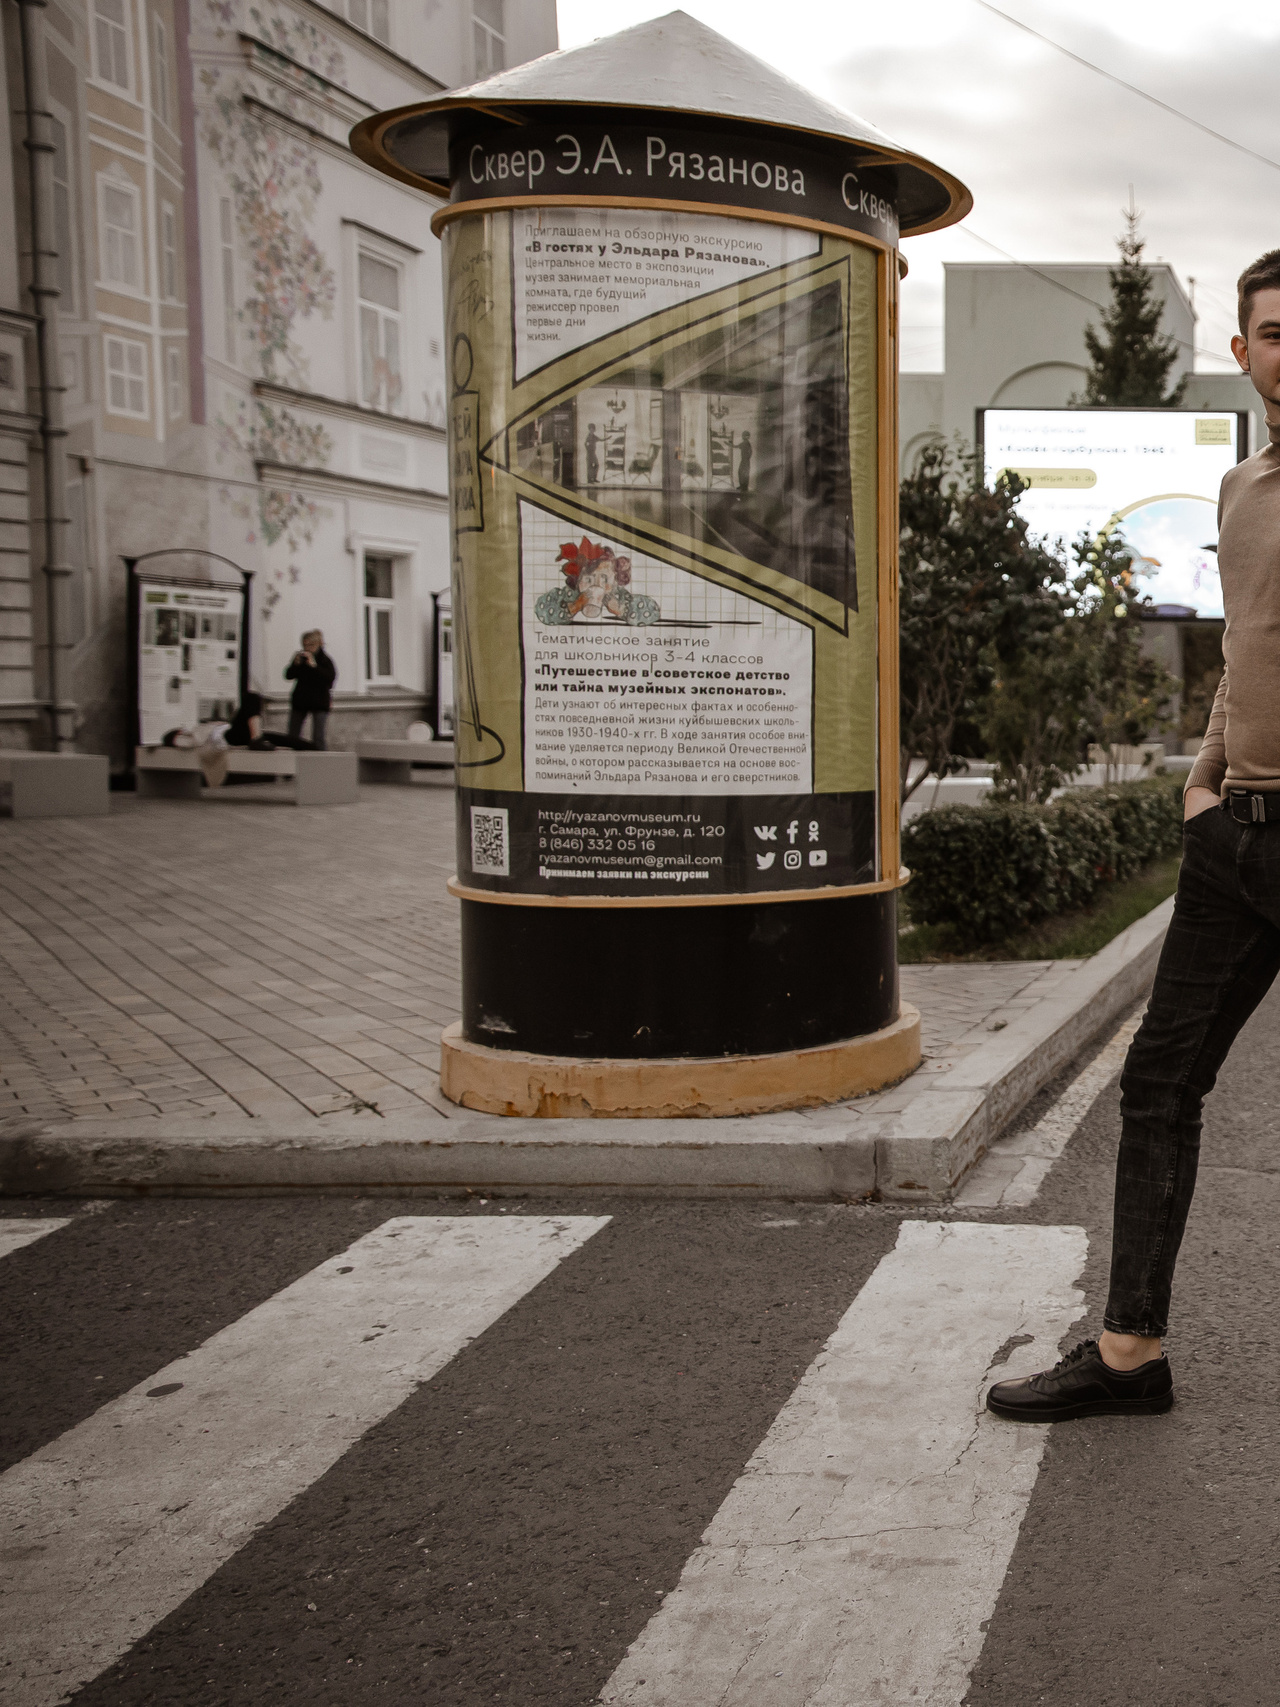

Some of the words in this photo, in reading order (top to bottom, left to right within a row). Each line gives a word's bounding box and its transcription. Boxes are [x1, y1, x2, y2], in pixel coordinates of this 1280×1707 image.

[469, 144, 546, 189] Сквер
[555, 134, 633, 175] Э.А.
[646, 136, 806, 196] Рязанова
[841, 172, 893, 238] Сквер
[525, 224, 600, 239] Приглашаем
[605, 229, 620, 238] на
[624, 227, 689, 244] обзорную
[694, 235, 763, 251] экскурсию
[525, 241, 541, 253] «В
[545, 243, 593, 253] гостях
[598, 244, 607, 257] у
[612, 242, 680, 260] Эльдара
[685, 247, 770, 268] Рязанова».
[525, 257, 595, 270] Центральное
[599, 260, 632, 270] место
[635, 261, 642, 270] в
[645, 263, 715, 276] экспозиции
[525, 273, 555, 285] музея
[558, 274, 611, 284] занимает
[614, 276, 701, 289] мемориальная
[525, 289, 571, 298] комната,
[574, 289, 593, 299] где
[596, 288, 647, 300] будущий
[526, 303, 576, 315] режиссер
[579, 304, 620, 315] провел
[526, 318, 562, 329] первые
[565, 319, 586, 327] дни
[526, 332, 561, 341] жизни.
[535, 632, 640, 646] Тематическое
[645, 636, 710, 648] занятие
[535, 651, 559, 661] для
[564, 651, 658, 662] школьников
[701, 654, 764, 664] классов
[535, 664, 637, 679] «Путешествие
[642, 669, 649, 677] в
[654, 669, 731, 679] советское
[735, 671, 790, 681] детство
[535, 683, 558, 692] или
[562, 680, 604, 693] тайна
[608, 682, 686, 696] музейных
[690, 686, 786, 696] экспонатов».
[535, 697, 559, 709] Дети
[562, 700, 600, 711] узнают
[603, 699, 616, 710] об
[619, 700, 687, 713] интересных
[691, 701, 733, 714] фактах
[736, 702, 743, 711] и
[746, 701, 798, 712] особенно-
[535, 714, 556, 722] стях
[558, 714, 635, 725] повседневной
[638, 715, 676, 724] жизни
[678, 714, 761, 727] куйбышевских
[763, 717, 799, 726] школь-
[535, 729, 564, 737] ников
[567, 726, 640, 739] 1930-1940-х
[643, 731, 657, 739] гг.
[660, 728, 668, 739] В
[671, 731, 698, 741] ходе
[701, 731, 746, 740] занятия
[748, 729, 785, 740] особое
[535, 743, 566, 752] мание
[569, 743, 624, 755] уделяется
[626, 745, 674, 755] периоду
[677, 743, 726, 754] Великой
[729, 743, 807, 754] Отечественной
[535, 755, 569, 767] войны,
[571, 758, 577, 766] о
[579, 758, 625, 769] котором
[628, 759, 720, 769] рассказывается
[723, 760, 737, 768] на
[739, 760, 776, 768] основе
[779, 760, 800, 768] вос-
[535, 771, 591, 781] поминаний
[594, 770, 641, 784] Эльдара
[644, 770, 698, 782] Рязанова
[701, 774, 708, 782] и
[711, 774, 730, 782] его
[732, 773, 800, 784] сверстников.
[538, 809, 700, 824] http://ryazanovmuseum.ru
[538, 825, 546, 834] г.
[550, 824, 600, 838] Самара,
[603, 827, 621, 838] ул.
[625, 826, 679, 839] Фрунзе,
[683, 828, 695, 838] д.
[700, 825, 726, 837] 120
[539, 837, 547, 848] 8
[550, 838, 584, 852] (846)
[587, 839, 613, 850] 332
[617, 839, 636, 851] 05
[641, 840, 656, 851] 16
[539, 854, 723, 868] ryazanovmuseum@gmail.com
[539, 865, 595, 880] Принимаем
[596, 870, 633, 879] заявки
[634, 871, 648, 879] на
[650, 870, 709, 882] экскурсии
